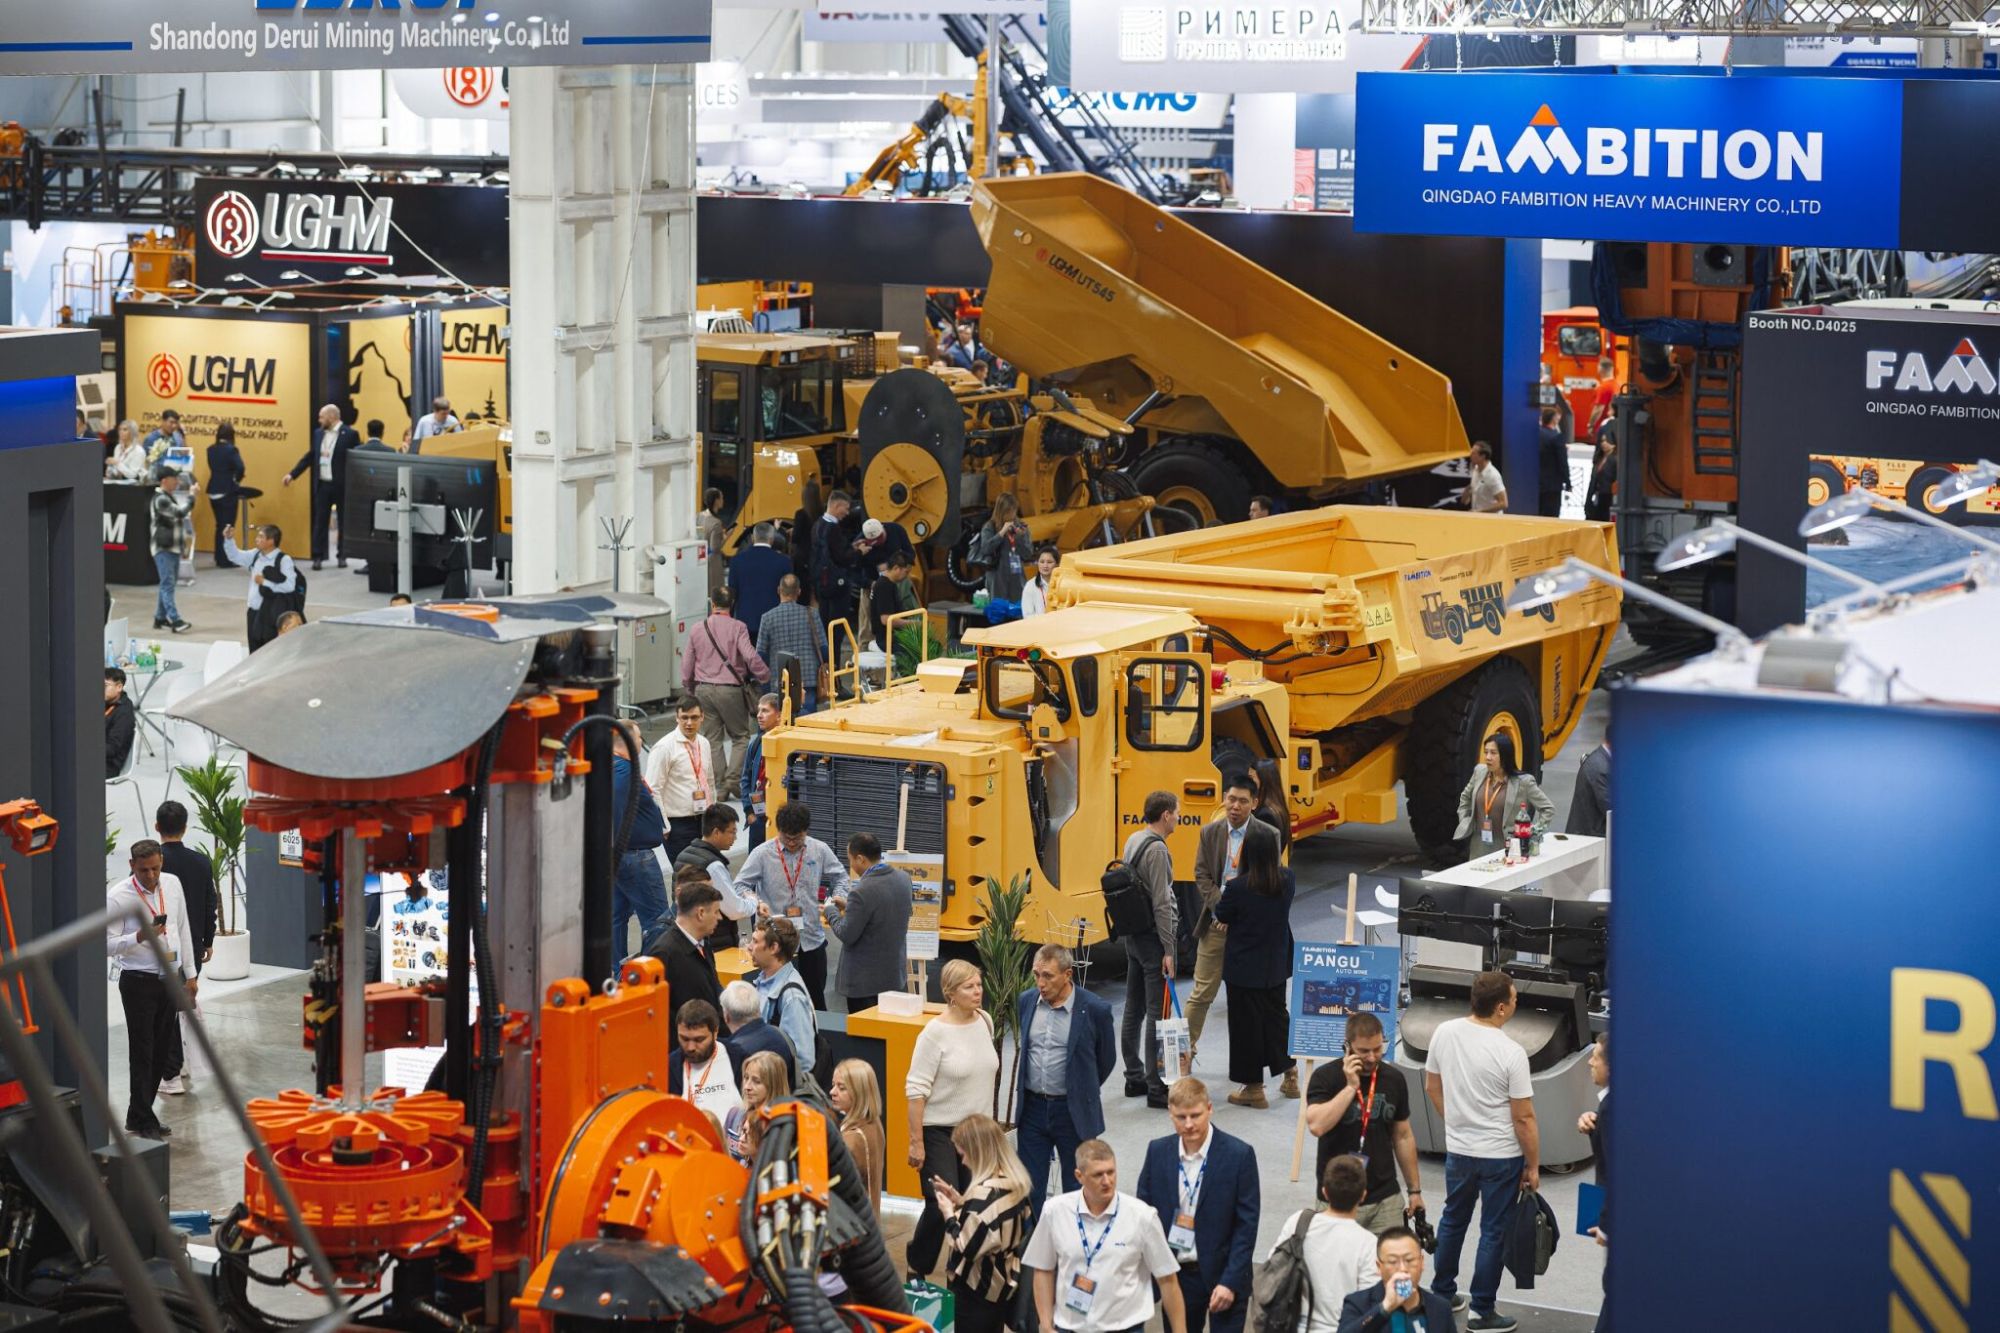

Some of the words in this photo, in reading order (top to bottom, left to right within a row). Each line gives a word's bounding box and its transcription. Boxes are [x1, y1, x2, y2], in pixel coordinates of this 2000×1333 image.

[1178, 10, 1341, 34] РИМЕРА
[150, 22, 256, 57] Shandong
[264, 22, 319, 49] Derui
[326, 22, 394, 55] Mining
[401, 21, 499, 53] Machinery
[1085, 91, 1197, 111] CMG
[1423, 124, 1823, 181] FAMBITION
[1422, 189, 1496, 204] QINGDAO
[1501, 191, 1587, 207] FAMBITION
[1593, 194, 1647, 209] HEAVY
[1651, 196, 1751, 212] MACHINERY
[1755, 199, 1822, 215] CO.,LTD
[262, 193, 393, 251] UGHM
[1749, 317, 1788, 330] Booth
[1791, 318, 1857, 333] NO.D4025
[188, 355, 276, 395] UGHM
[1866, 350, 2000, 395] FAM
[1866, 401, 1926, 416] QINGDAO
[1930, 405, 2000, 420] FAMBITION
[1123, 814, 1201, 826] FAION
[283, 835, 300, 845] 6025
[1303, 953, 1360, 968] PANGU
[1891, 967, 2000, 1121] R
[694, 1084, 726, 1095] ACOSTE
